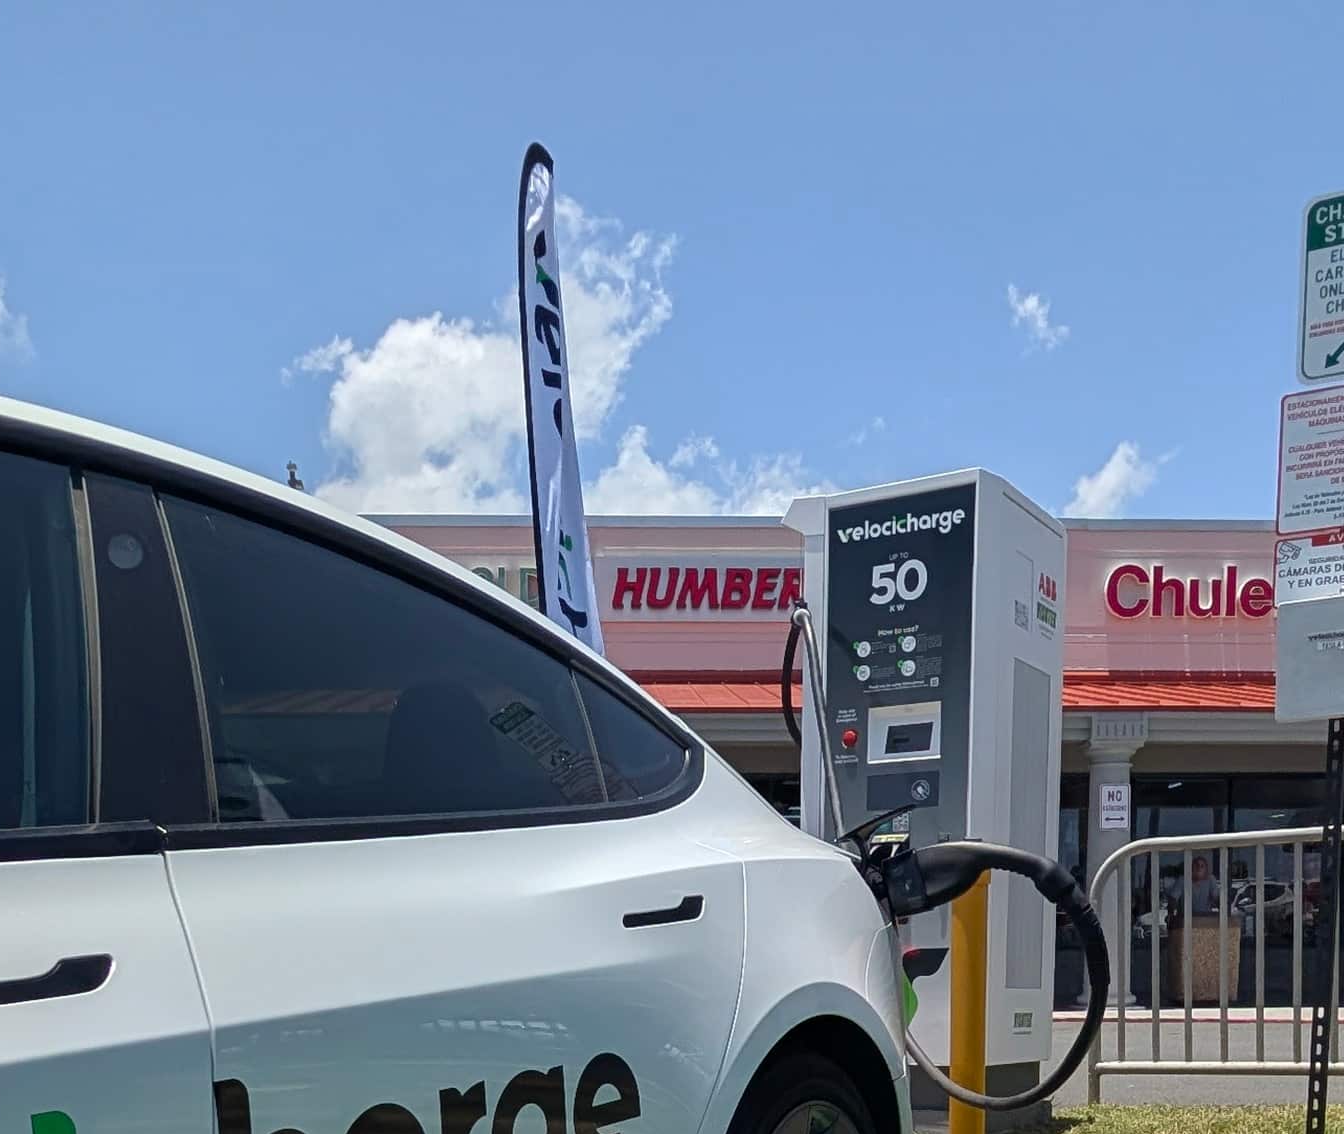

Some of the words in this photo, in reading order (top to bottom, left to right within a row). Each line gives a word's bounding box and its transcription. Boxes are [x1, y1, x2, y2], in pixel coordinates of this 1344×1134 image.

[1315, 265, 1343, 283] CAR
[837, 508, 965, 543] velocicharge
[1278, 563, 1332, 578] CÁMARAS
[869, 559, 927, 605] 50
[1106, 564, 1273, 618] Chule
[1288, 580, 1296, 589] Y
[1298, 579, 1313, 588] EN
[1107, 790, 1123, 801] NO
